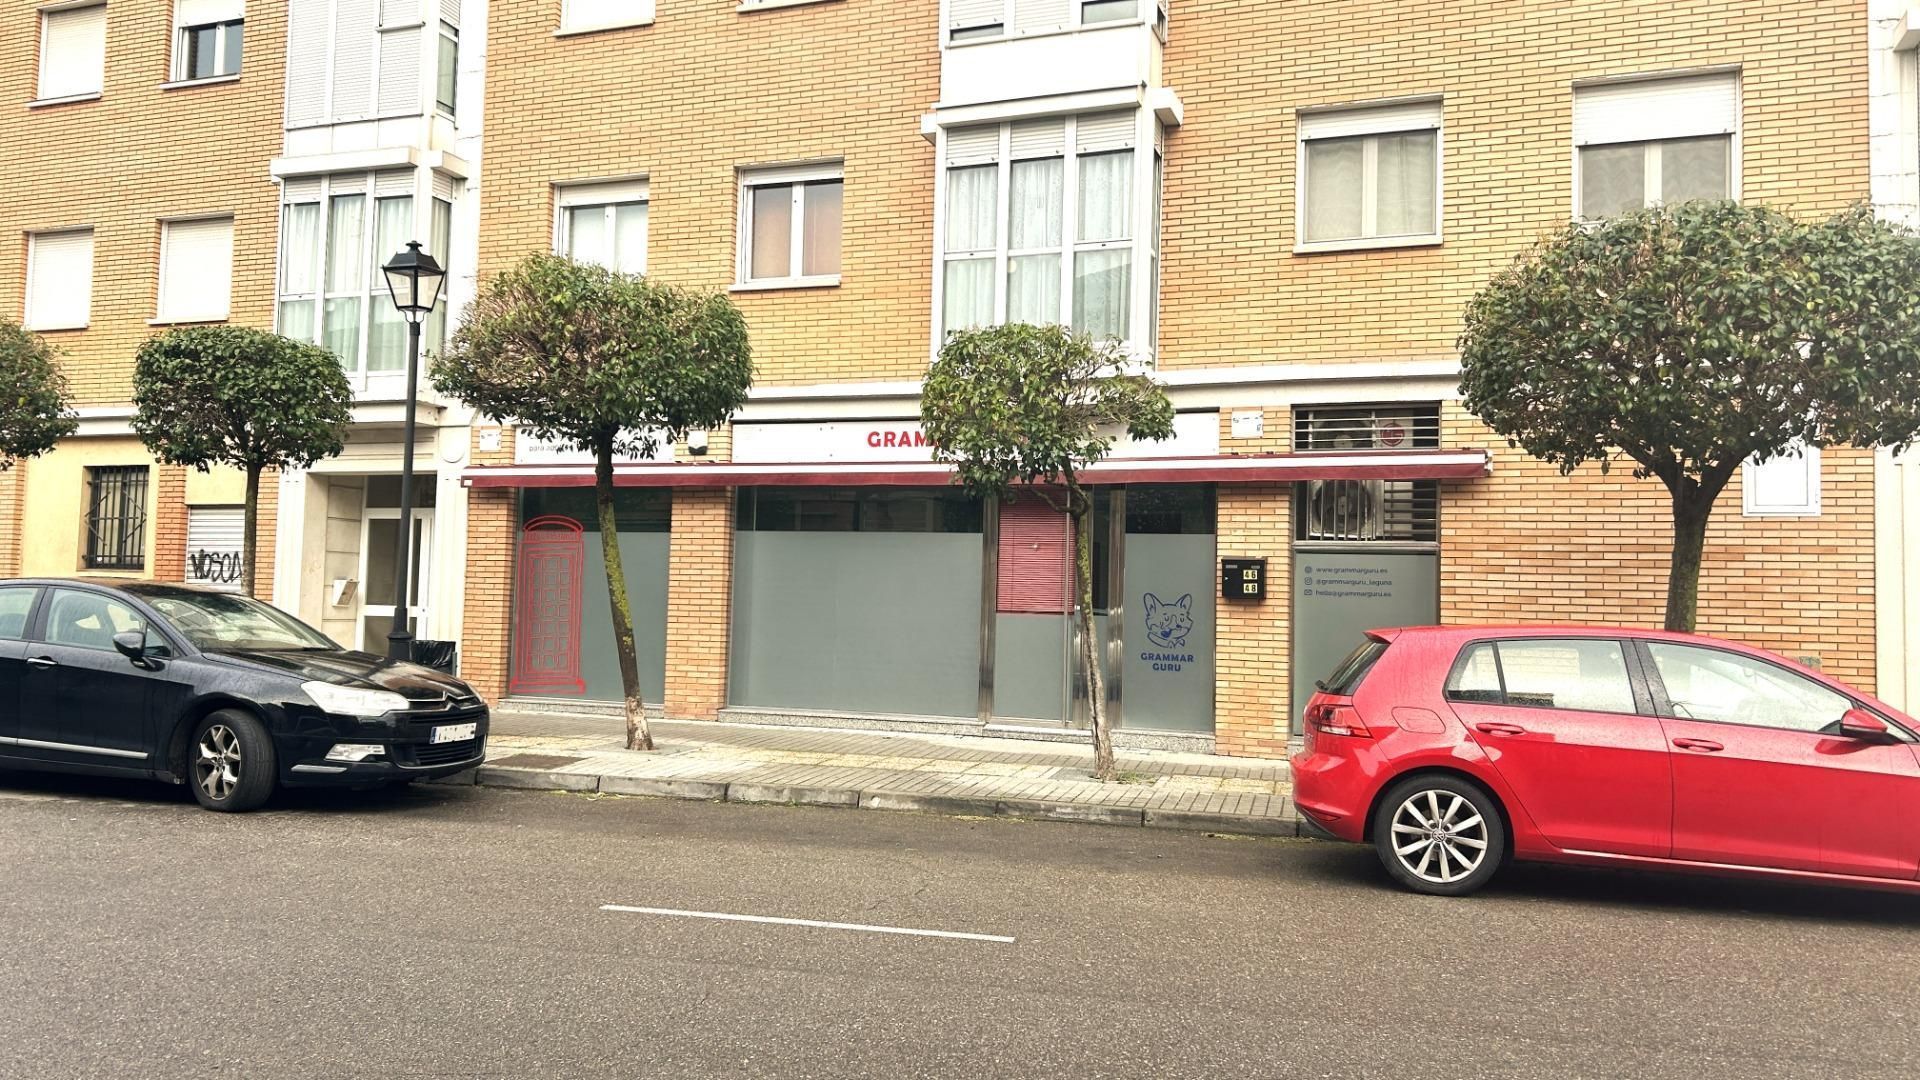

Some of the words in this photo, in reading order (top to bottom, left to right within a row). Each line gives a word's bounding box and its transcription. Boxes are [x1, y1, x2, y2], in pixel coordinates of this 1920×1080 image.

[867, 431, 940, 448] GRAM
[1244, 570, 1256, 579] 46
[1244, 584, 1256, 593] 48
[1140, 652, 1194, 662] GRAMMAR
[1152, 662, 1181, 672] GURU
